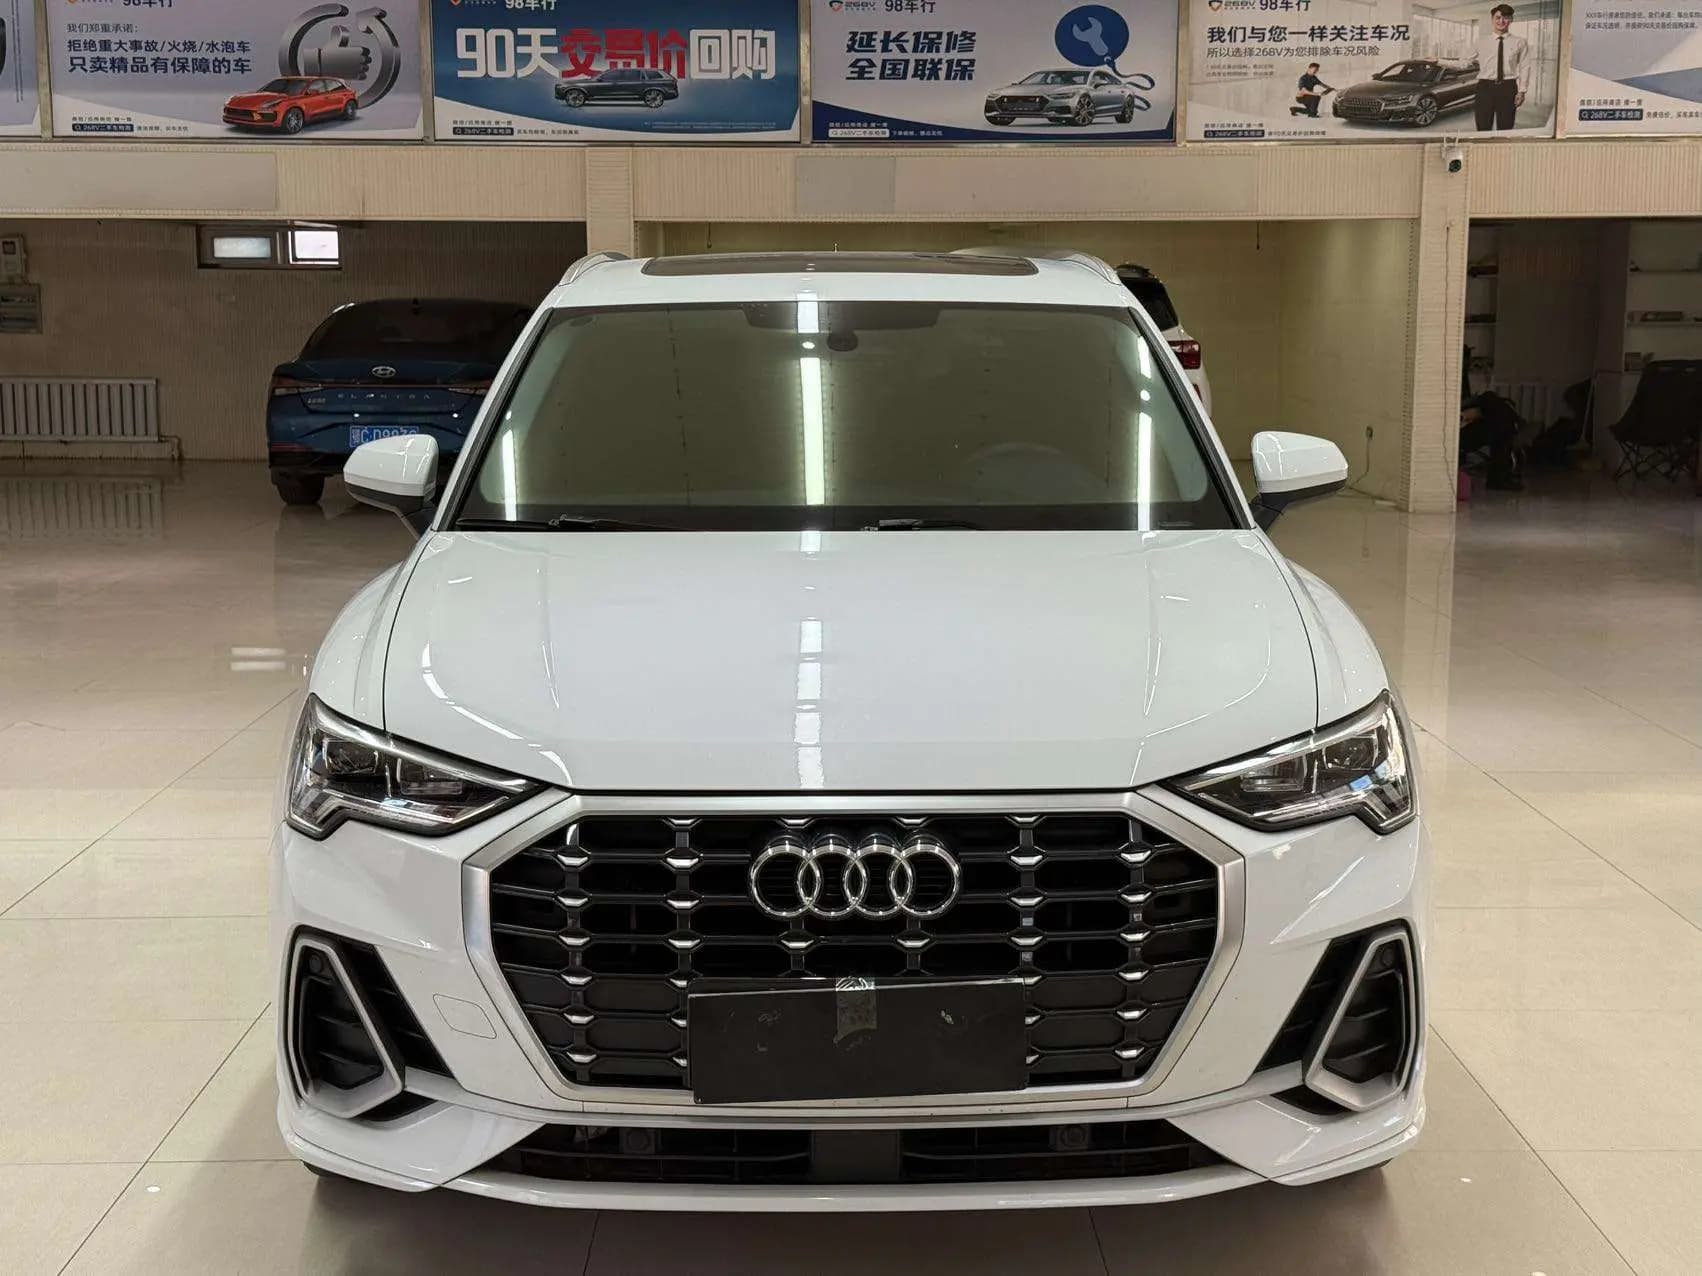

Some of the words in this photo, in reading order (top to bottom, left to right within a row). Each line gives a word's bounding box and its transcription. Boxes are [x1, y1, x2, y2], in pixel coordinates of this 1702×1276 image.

[885, 0, 936, 13] 98车行
[1259, 0, 1310, 11] 98车行
[1207, 24, 1410, 43] 我们与您一样关注车况
[67, 39, 251, 53] 拒绝重大事故/火烧/水泡车
[845, 31, 977, 54] 延长保修
[1206, 45, 1380, 58] 所以选择268V为您排除车况风险
[68, 56, 252, 74] 只卖精品有保障的车
[845, 58, 977, 81] 全国联保
